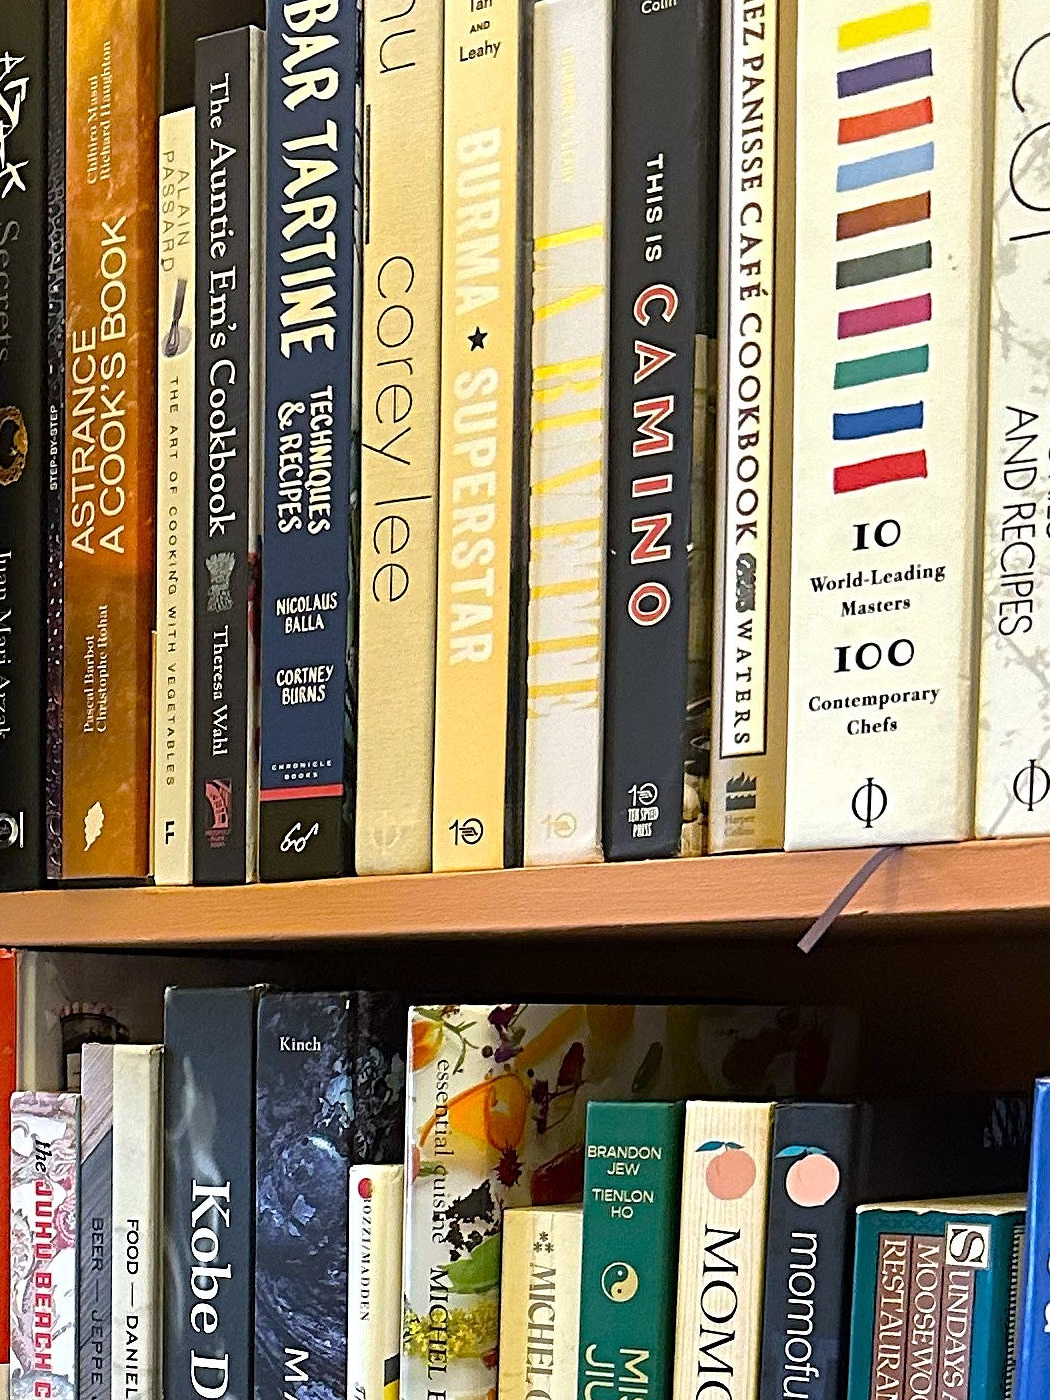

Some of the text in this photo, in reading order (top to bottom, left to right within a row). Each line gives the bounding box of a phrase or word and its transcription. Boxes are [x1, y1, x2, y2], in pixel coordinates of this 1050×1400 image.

[160, 151, 175, 273] PASSARD
[178, 170, 190, 247] ALAIN
[280, 0, 339, 360] BAR TARTINE
[208, 73, 238, 538] The Auntie Em's Cookbook
[99, 215, 128, 555] A COOK'S BOOK
[449, 126, 501, 666] BURMA SUPERSTAR
[628, 153, 678, 626] THIS IS CAMINO
[733, 57, 770, 746] PANISSE CAFÉ COOKBOOK WATERS
[71, 330, 96, 555] ASTRANCE
[277, 402, 302, 533] & RECIPES
[307, 385, 333, 535] TECHNIQUES
[362, 256, 432, 602] corey lee
[852, 520, 902, 551] 10
[165, 376, 179, 786] THE ART OF COOKING WITH VEGETABLES
[276, 592, 338, 616] NICOLAUS
[810, 563, 946, 593] World-Leading
[840, 595, 911, 618] Masters
[284, 615, 324, 633] BALLA
[834, 638, 915, 673] 100
[211, 625, 230, 757] Theresa Wahl
[276, 664, 334, 687] CORTNEY
[282, 685, 326, 705] BURNS
[808, 685, 940, 713] Contemporary
[847, 717, 897, 736] Chefs
[280, 1036, 321, 1053] Kinch
[434, 1059, 450, 1156] essential
[35, 1139, 52, 1173] the
[588, 1144, 661, 1161] BRANDON
[607, 1161, 640, 1176] JEW
[34, 1180, 52, 1261] JUHU
[431, 1161, 449, 1244] cuisine
[592, 1188, 654, 1204] TIENLON
[611, 1206, 633, 1220] HO
[190, 1181, 232, 1334] Kobe
[34, 1272, 52, 1372] BEACH
[427, 1268, 449, 1380] MICHEL
